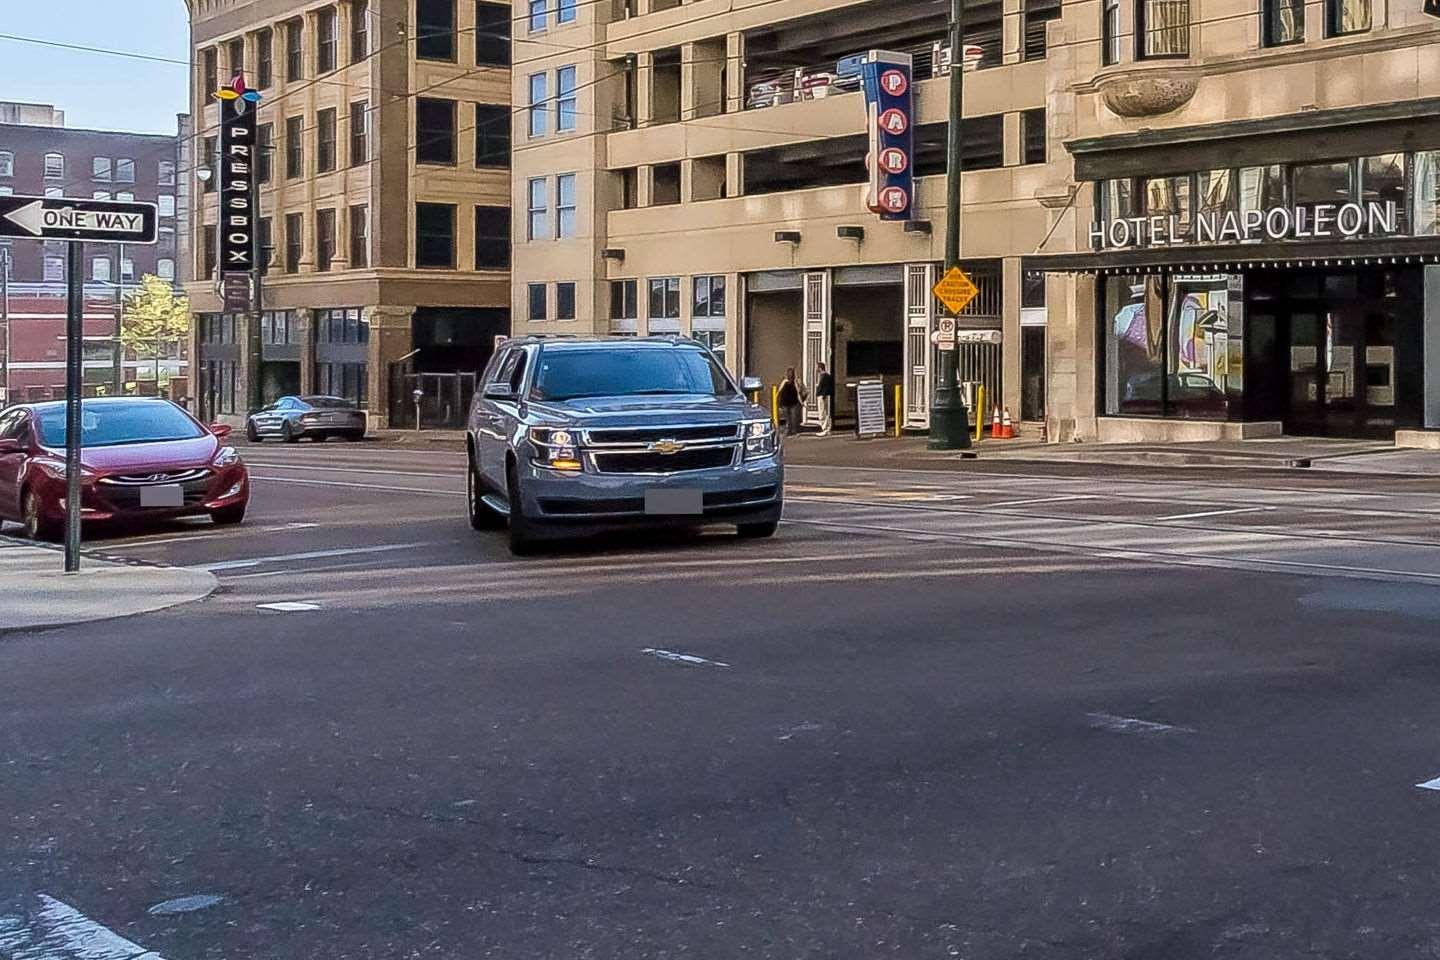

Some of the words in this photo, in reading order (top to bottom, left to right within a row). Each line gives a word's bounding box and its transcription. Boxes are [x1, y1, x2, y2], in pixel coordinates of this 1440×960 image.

[887, 74, 905, 209] PARK
[43, 210, 88, 227] ONE
[95, 213, 140, 230] WAY
[1089, 214, 1184, 250] HOTEL
[1196, 199, 1395, 241] NAPOLEON
